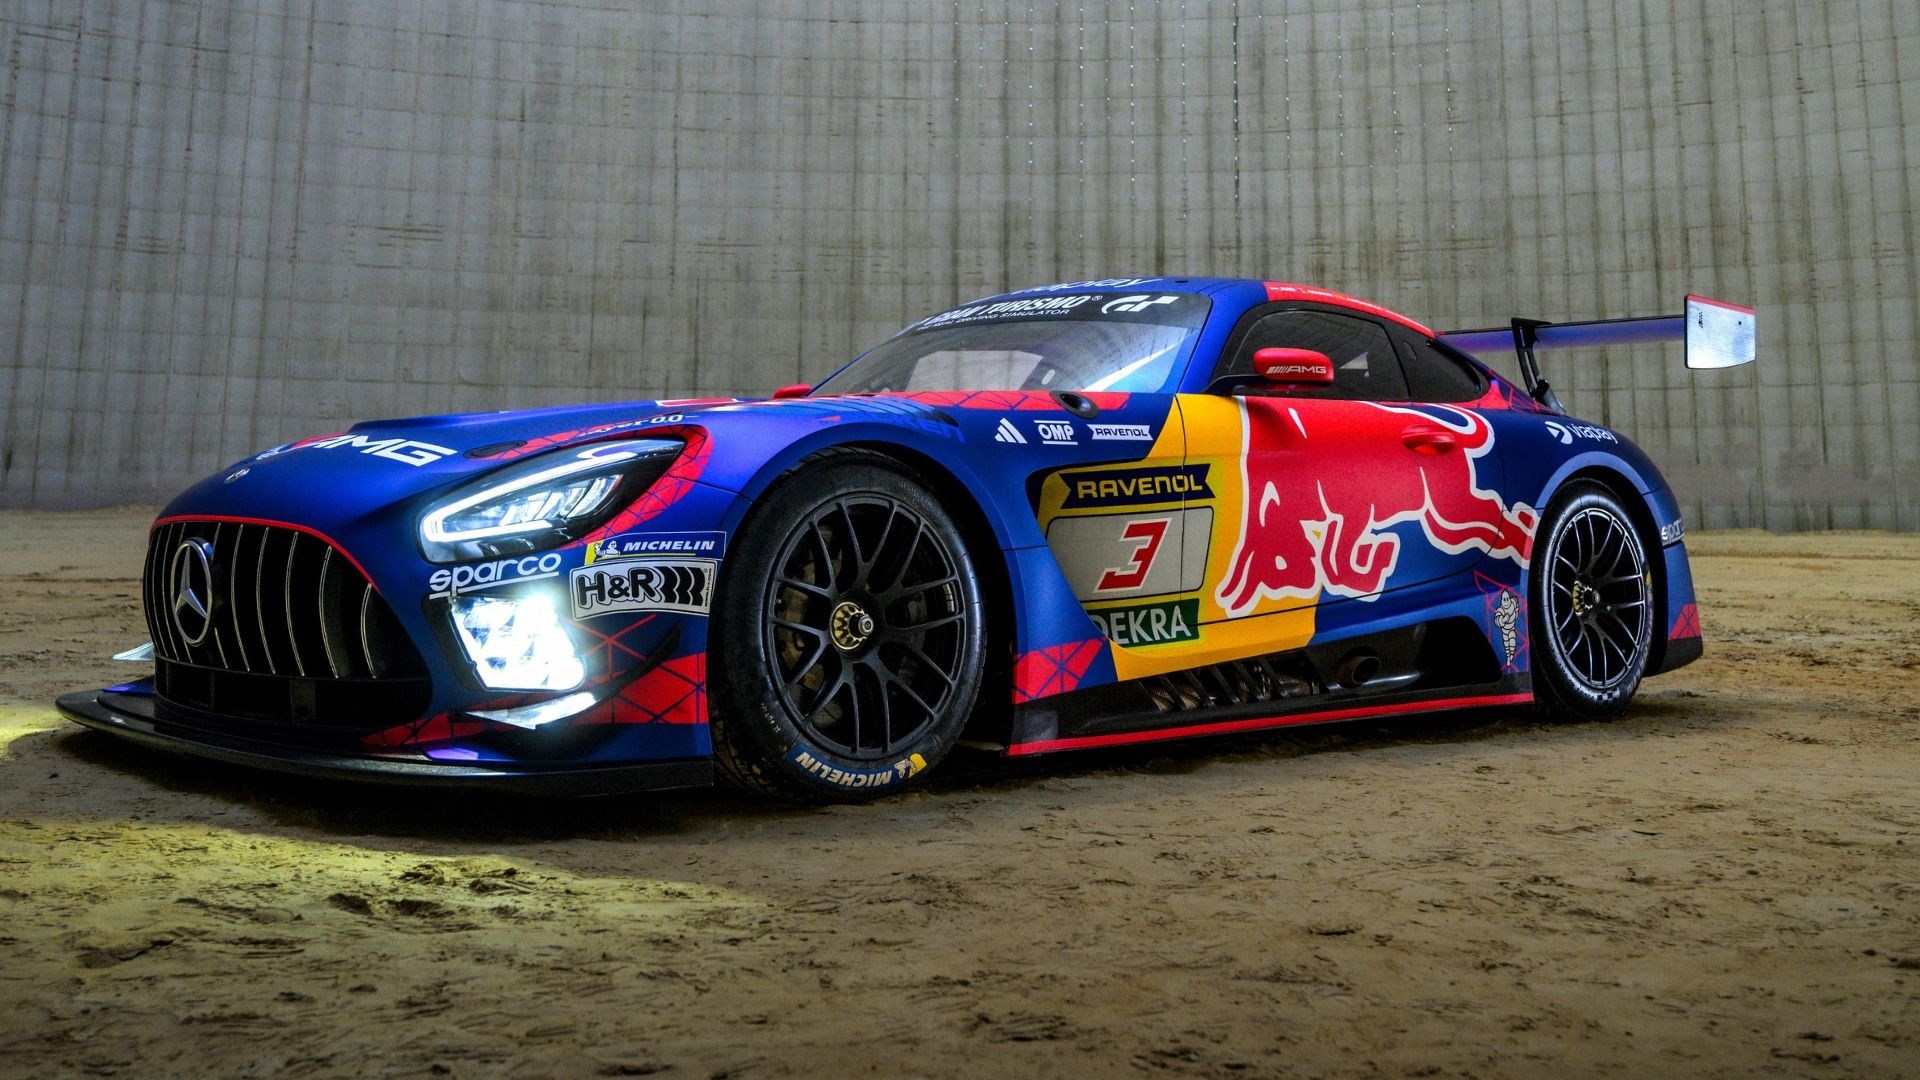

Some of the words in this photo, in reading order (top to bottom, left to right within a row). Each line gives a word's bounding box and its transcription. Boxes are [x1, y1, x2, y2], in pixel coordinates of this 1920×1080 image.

[1000, 308, 1070, 319] SIMULATOR
[1286, 366, 1327, 374] AMG
[1037, 422, 1075, 442] OMP
[1095, 427, 1148, 438] RAVENOL
[1077, 474, 1203, 499] RAVENOL
[623, 540, 715, 552] MICHELIN
[1093, 517, 1172, 594] 3
[429, 553, 562, 597] sparco
[576, 568, 658, 607] H&R
[794, 751, 893, 788] MICHELIN
